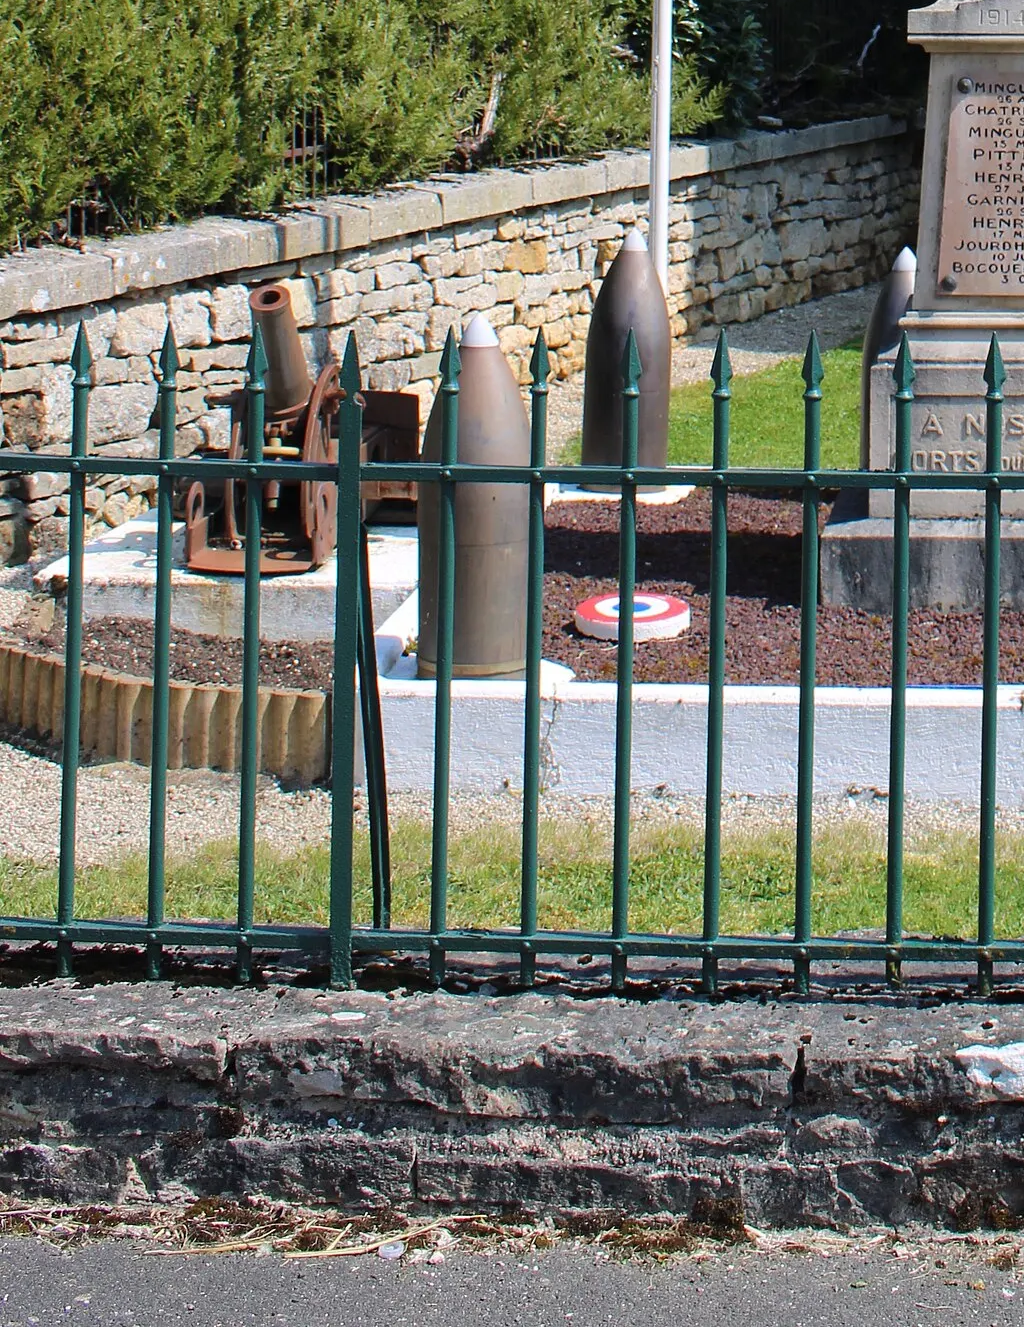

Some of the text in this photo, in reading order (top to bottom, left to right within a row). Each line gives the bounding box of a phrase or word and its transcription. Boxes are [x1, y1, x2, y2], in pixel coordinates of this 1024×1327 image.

[997, 118, 1012, 126] 26
[993, 253, 1005, 261] 10
[906, 450, 982, 472] ORTS
